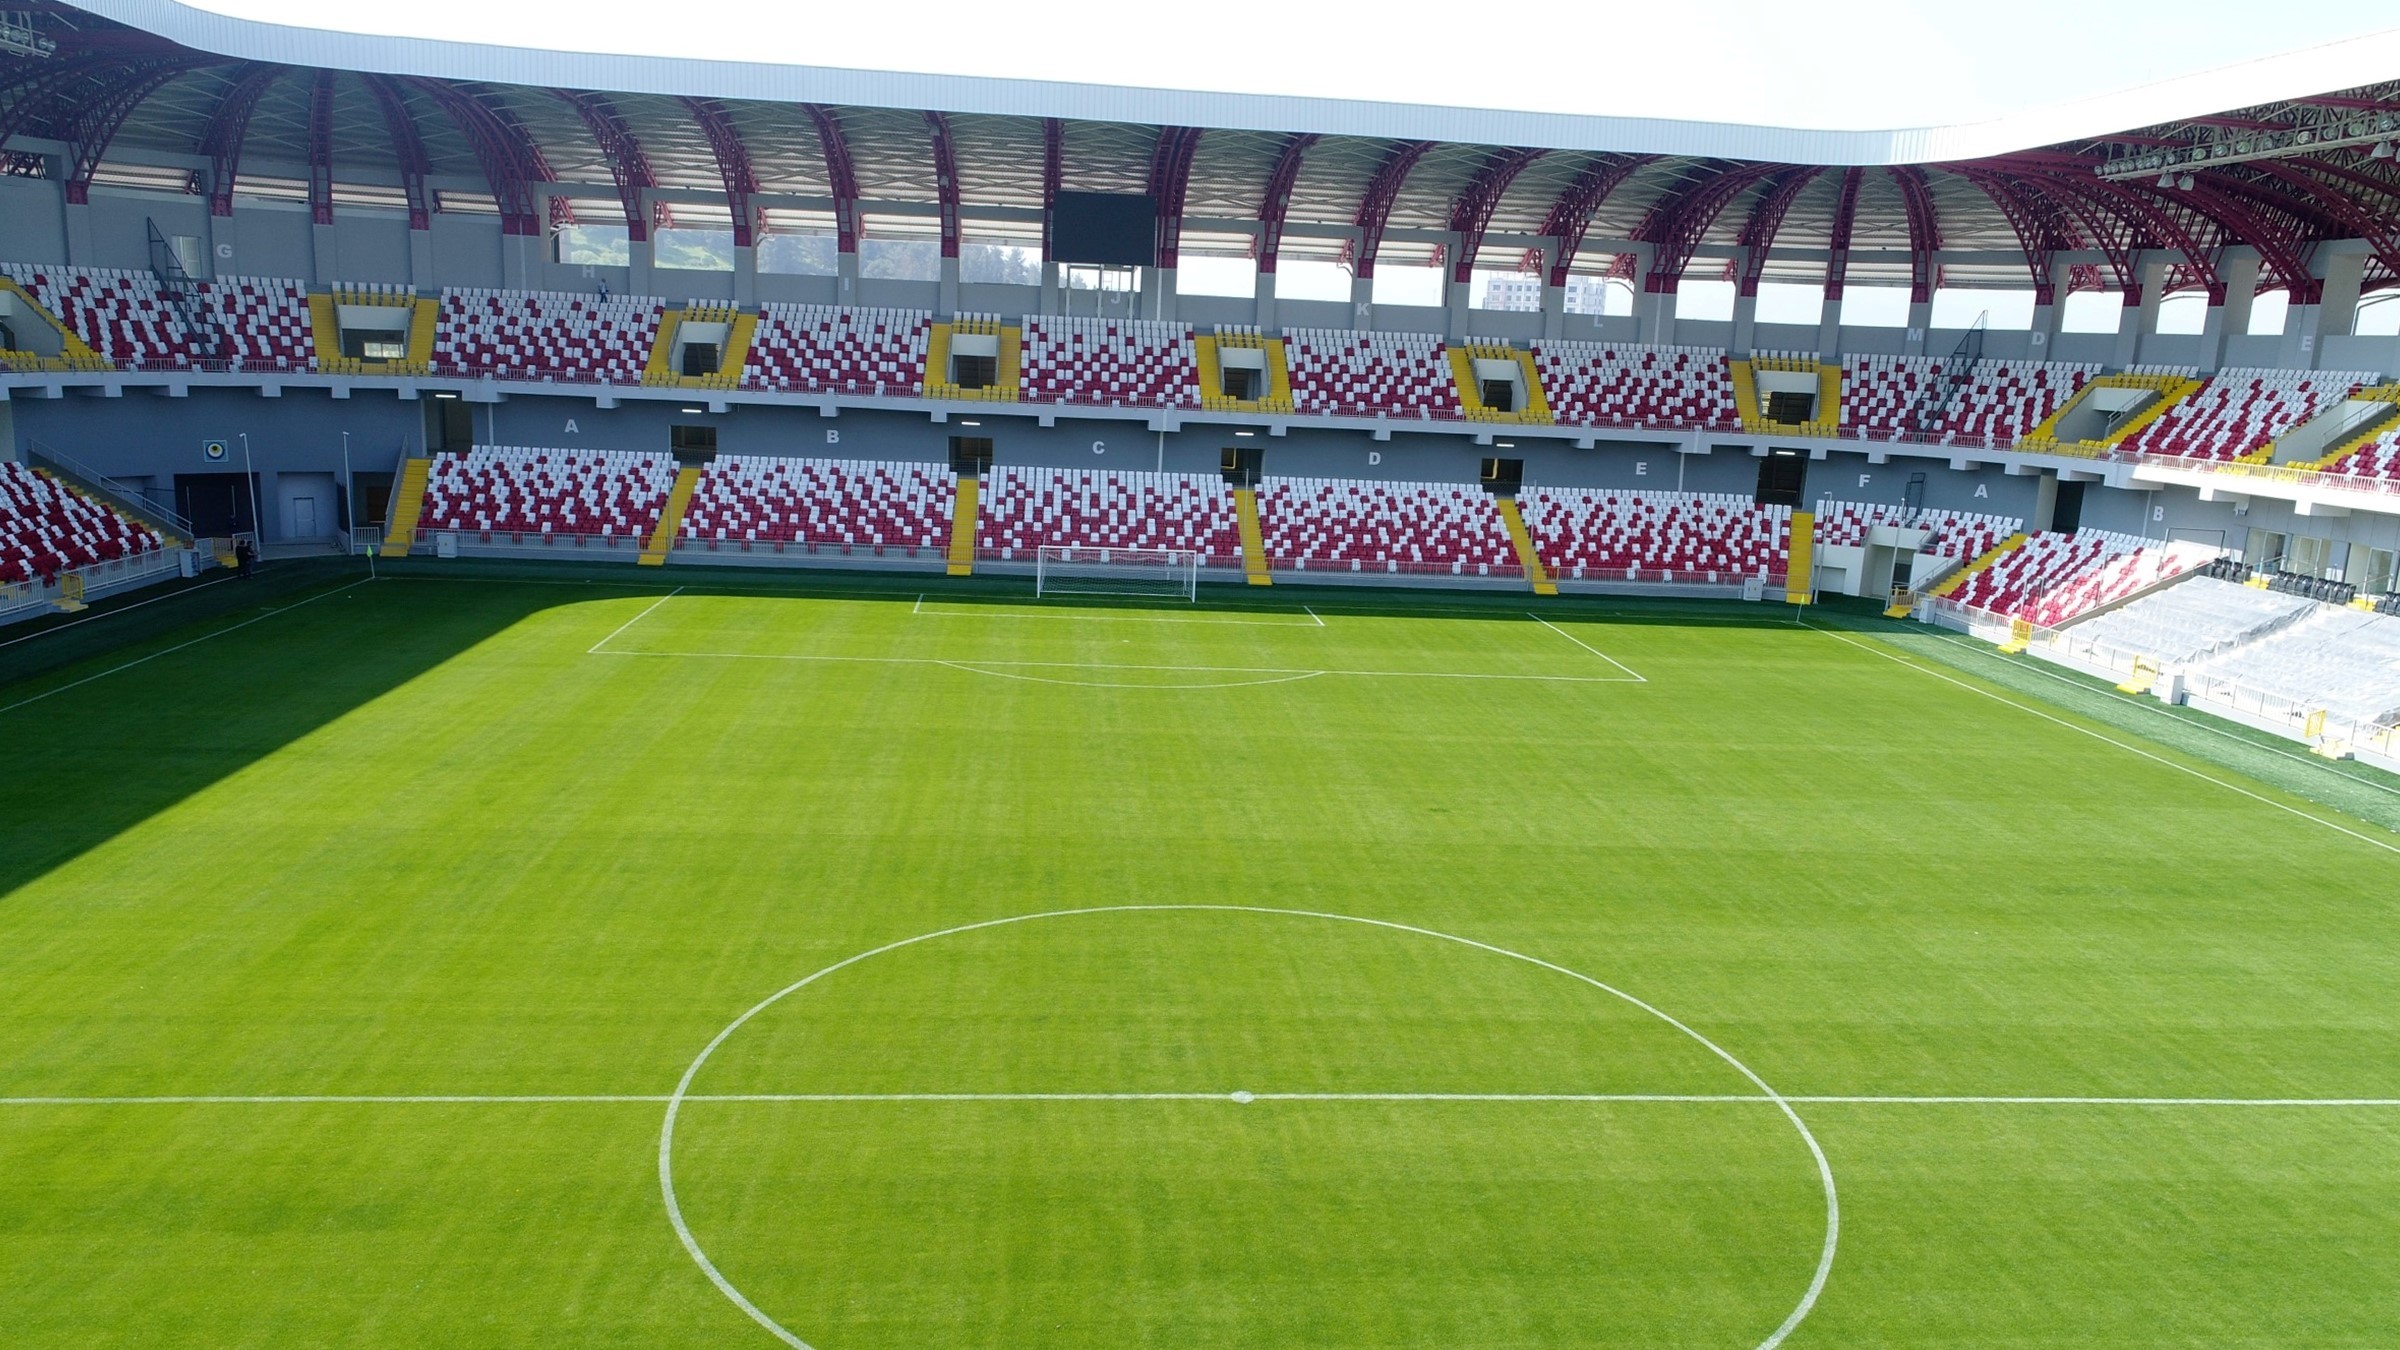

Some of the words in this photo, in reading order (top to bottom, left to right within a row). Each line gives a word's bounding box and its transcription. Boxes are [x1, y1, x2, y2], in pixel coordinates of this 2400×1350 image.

[217, 244, 232, 258] G
[582, 265, 595, 278] H
[1356, 302, 1370, 316] K
[1907, 327, 1923, 341] M
[2032, 332, 2045, 345] D
[2301, 335, 2313, 351] E
[564, 419, 579, 433] A
[827, 429, 840, 443] B
[1092, 441, 1105, 454] C
[1369, 452, 1381, 465] D
[1636, 462, 1648, 475] E
[1858, 474, 1871, 487] F
[1973, 484, 1988, 498] A
[2153, 505, 2165, 521] B
